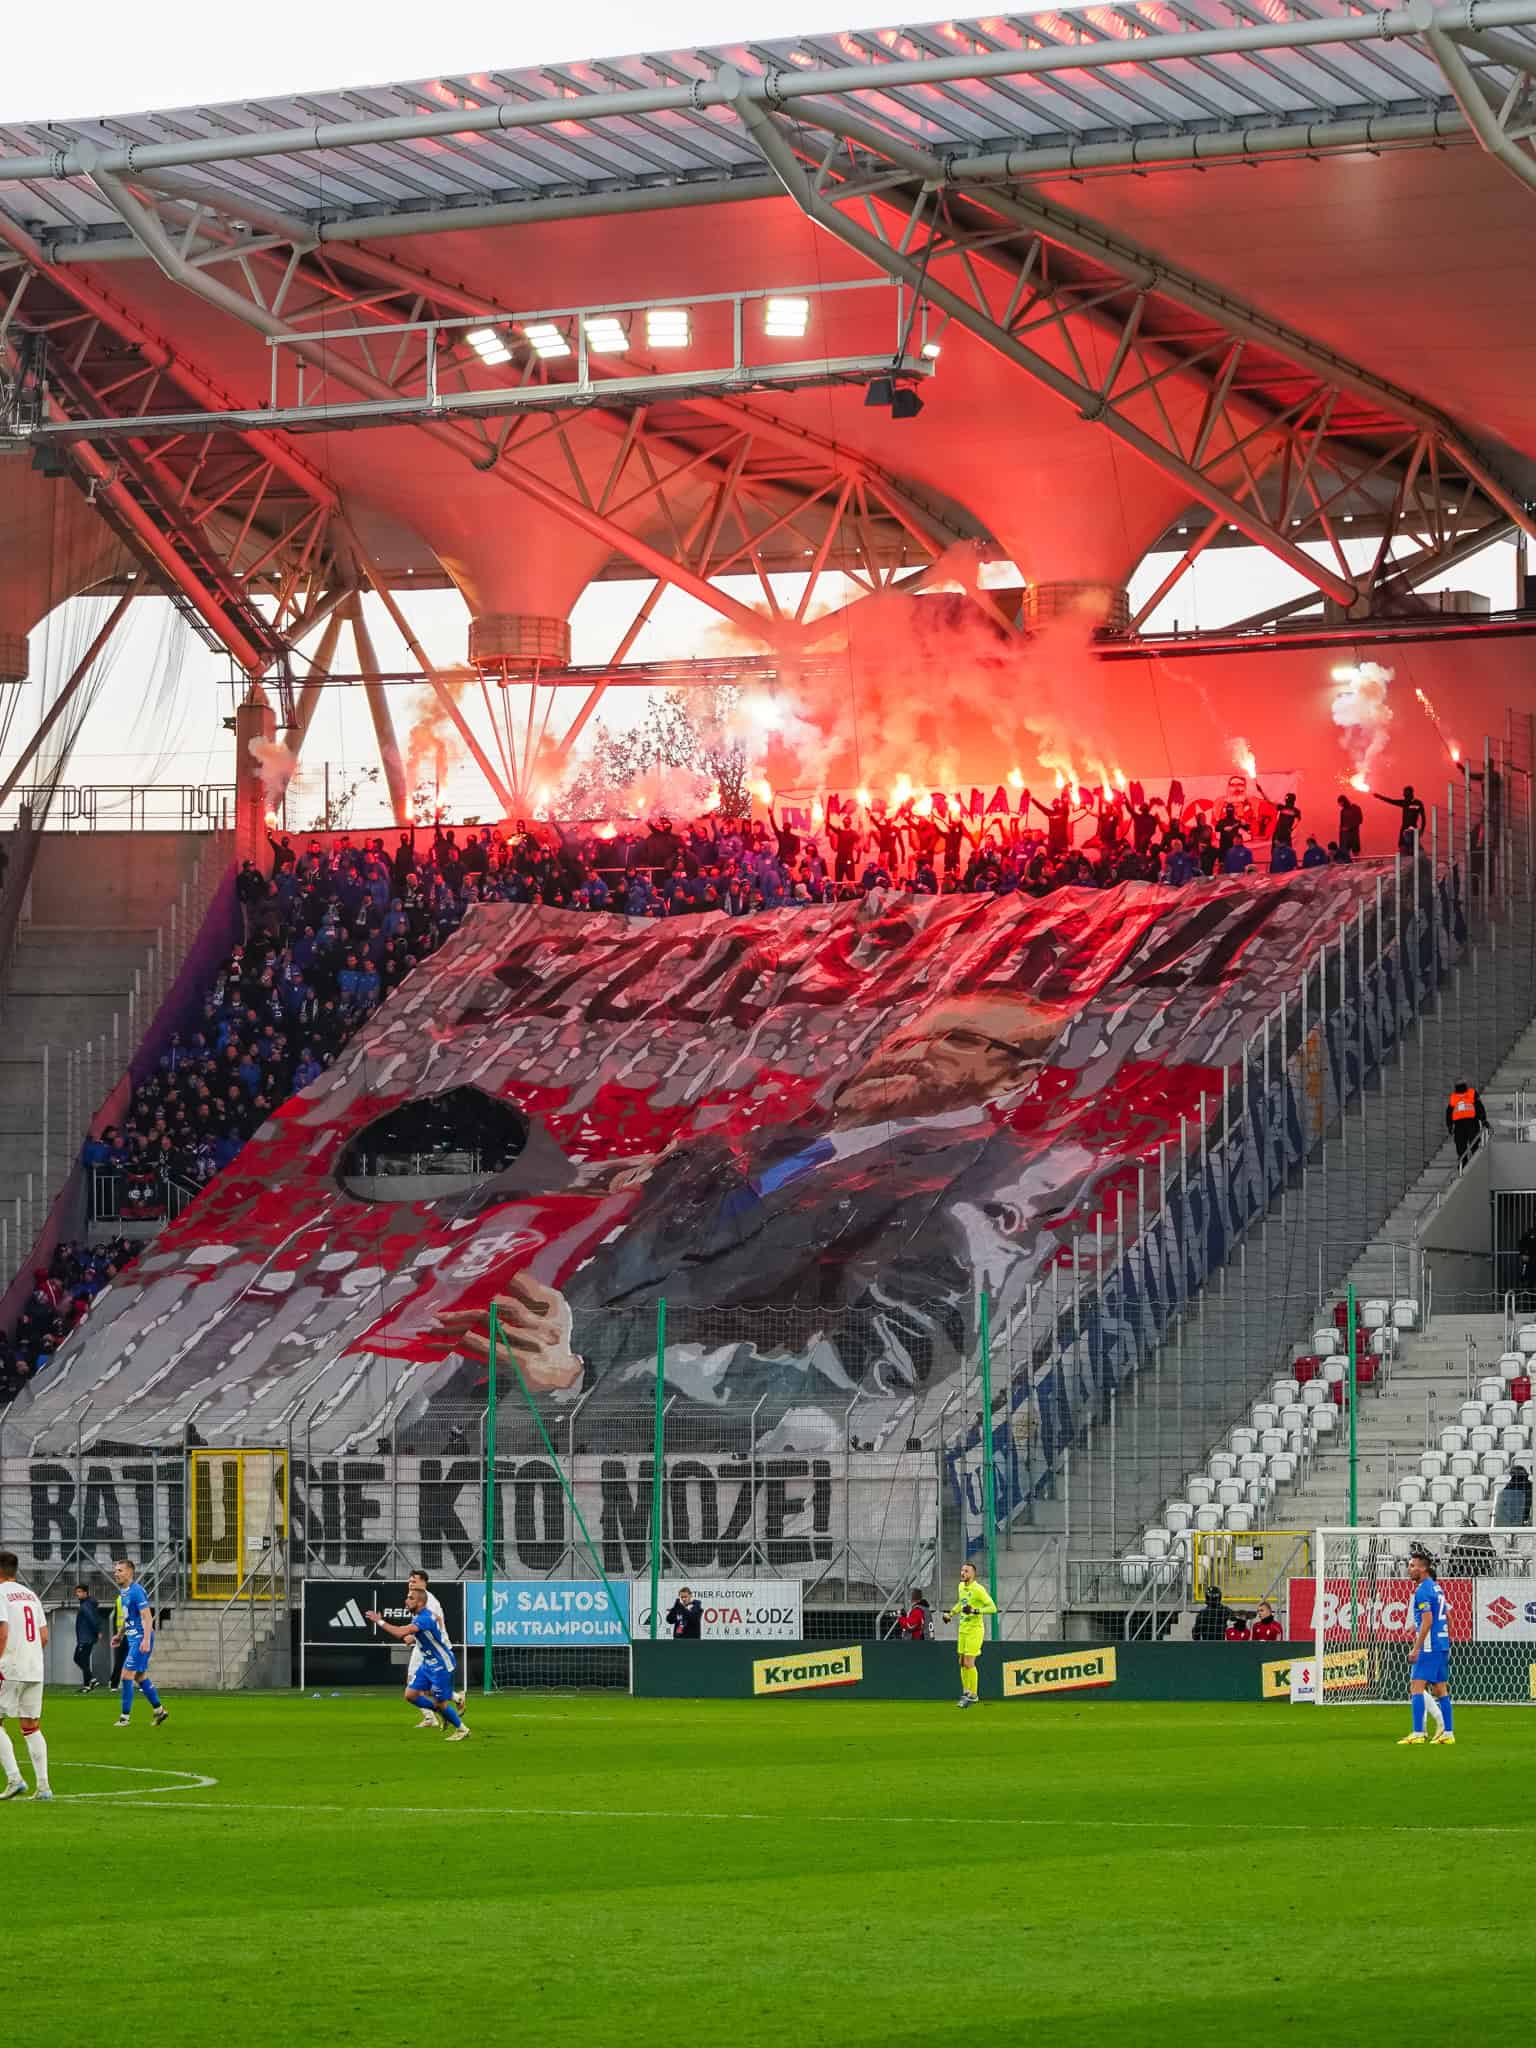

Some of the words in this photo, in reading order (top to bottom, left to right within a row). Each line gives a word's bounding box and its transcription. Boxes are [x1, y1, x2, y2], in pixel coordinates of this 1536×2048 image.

[517, 1591, 609, 1611] SALTOS
[715, 1591, 753, 1599] FLOTOWY
[24, 1605, 36, 1642] 8
[473, 1621, 519, 1636] PRK
[521, 1621, 622, 1636] TRAMPOLIN
[764, 1656, 850, 1684] Kramel
[1014, 1656, 1104, 1687] Kramel
[1273, 1659, 1366, 1688] Kmel
